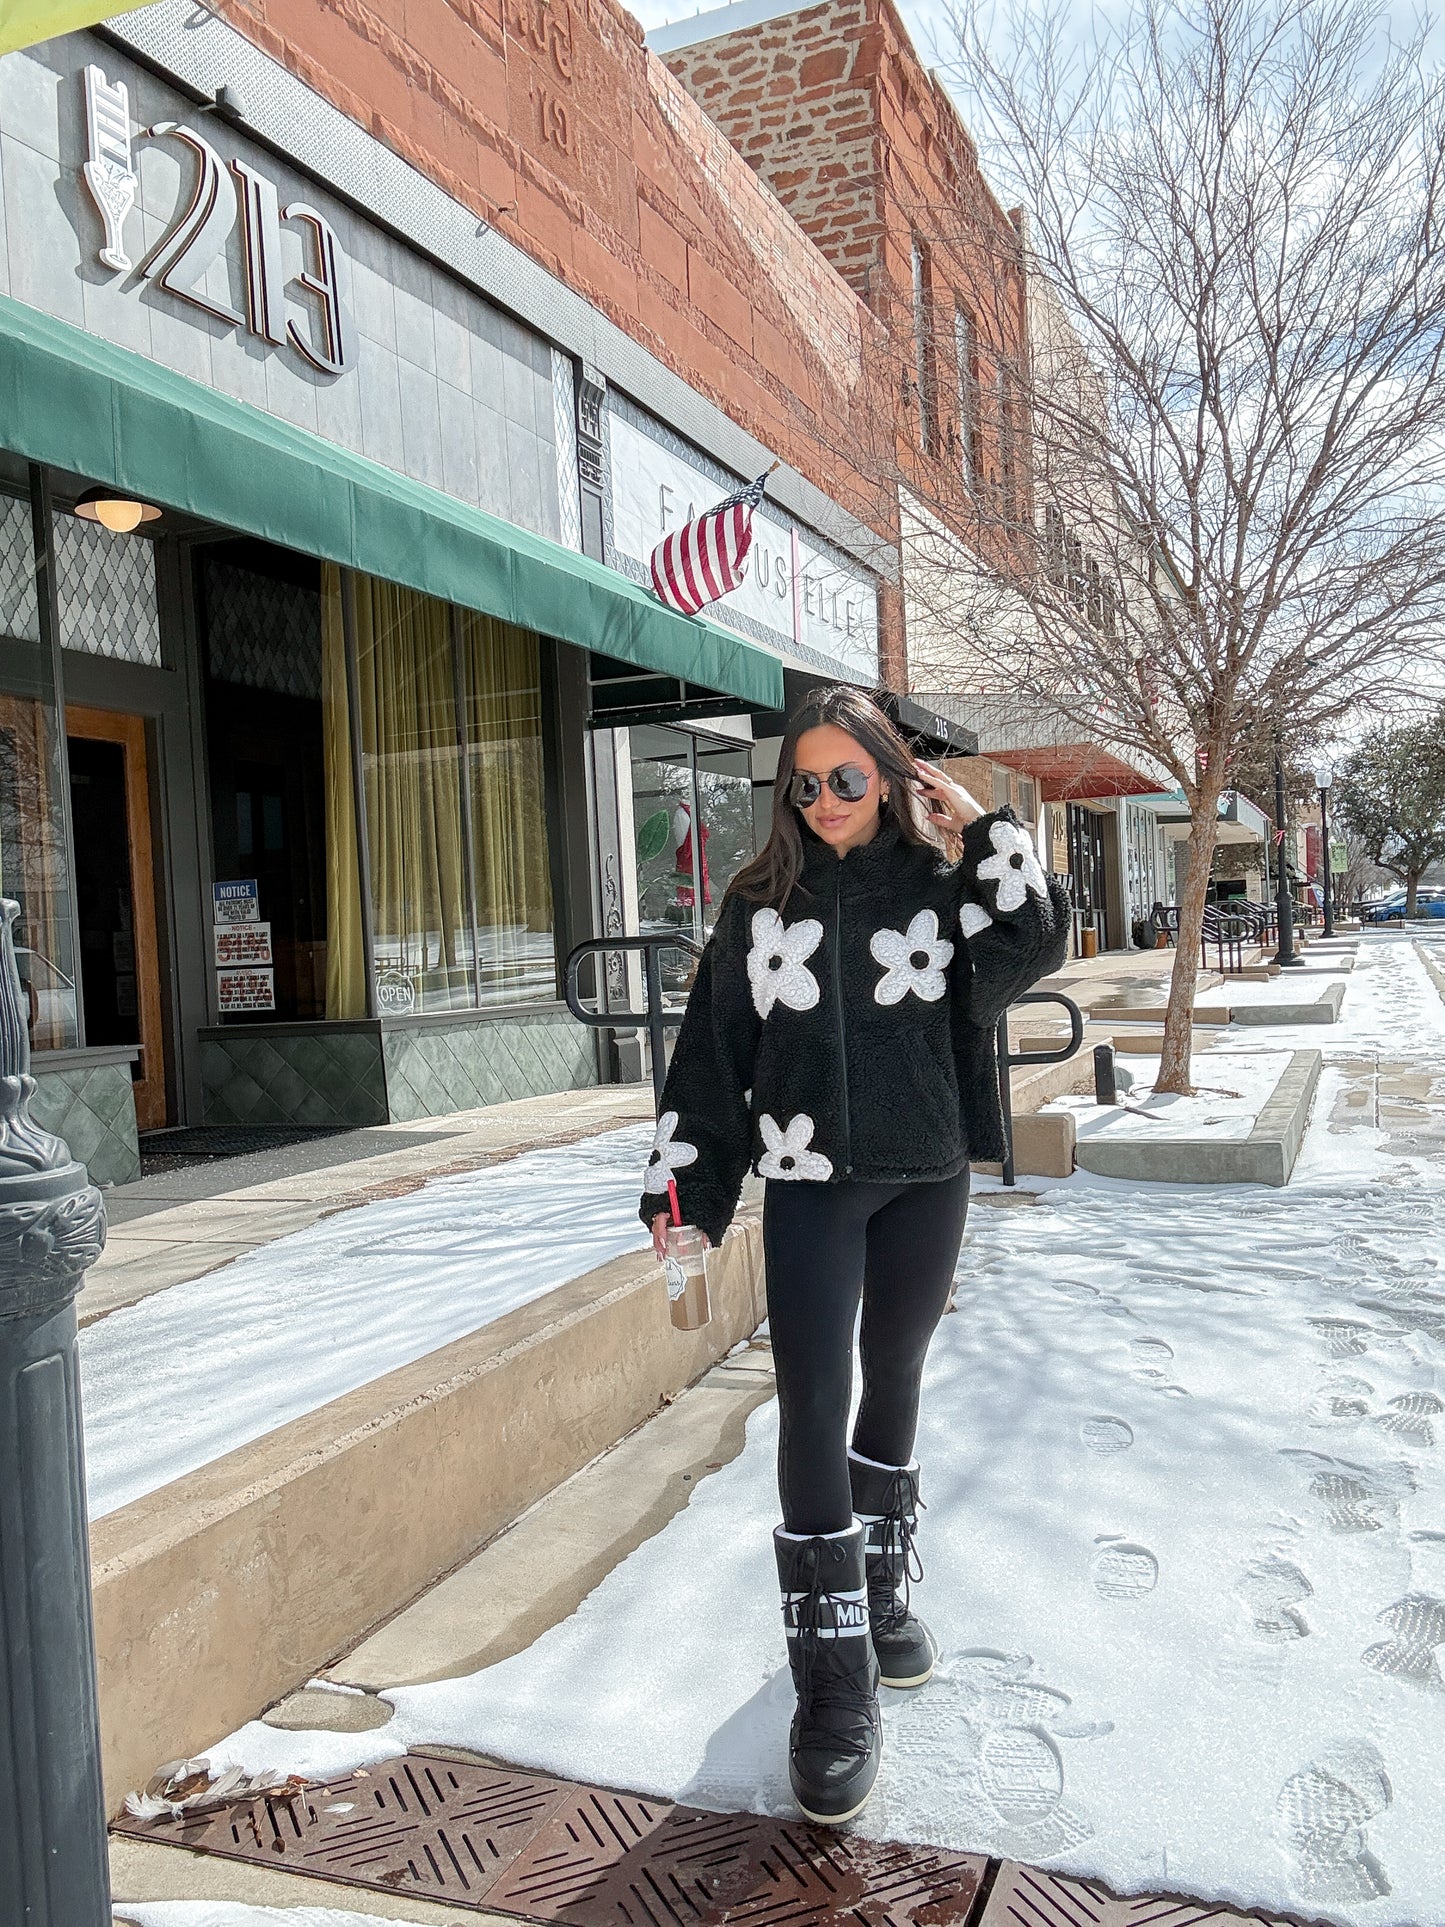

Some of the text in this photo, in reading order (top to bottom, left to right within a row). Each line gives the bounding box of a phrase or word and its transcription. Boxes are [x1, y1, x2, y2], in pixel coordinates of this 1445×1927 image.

[141, 121, 359, 375] 213
[805, 573, 857, 638] ELLE
[935, 717, 948, 740] 215
[220, 885, 251, 898] NOTICE
[380, 987, 412, 1002] OPEN
